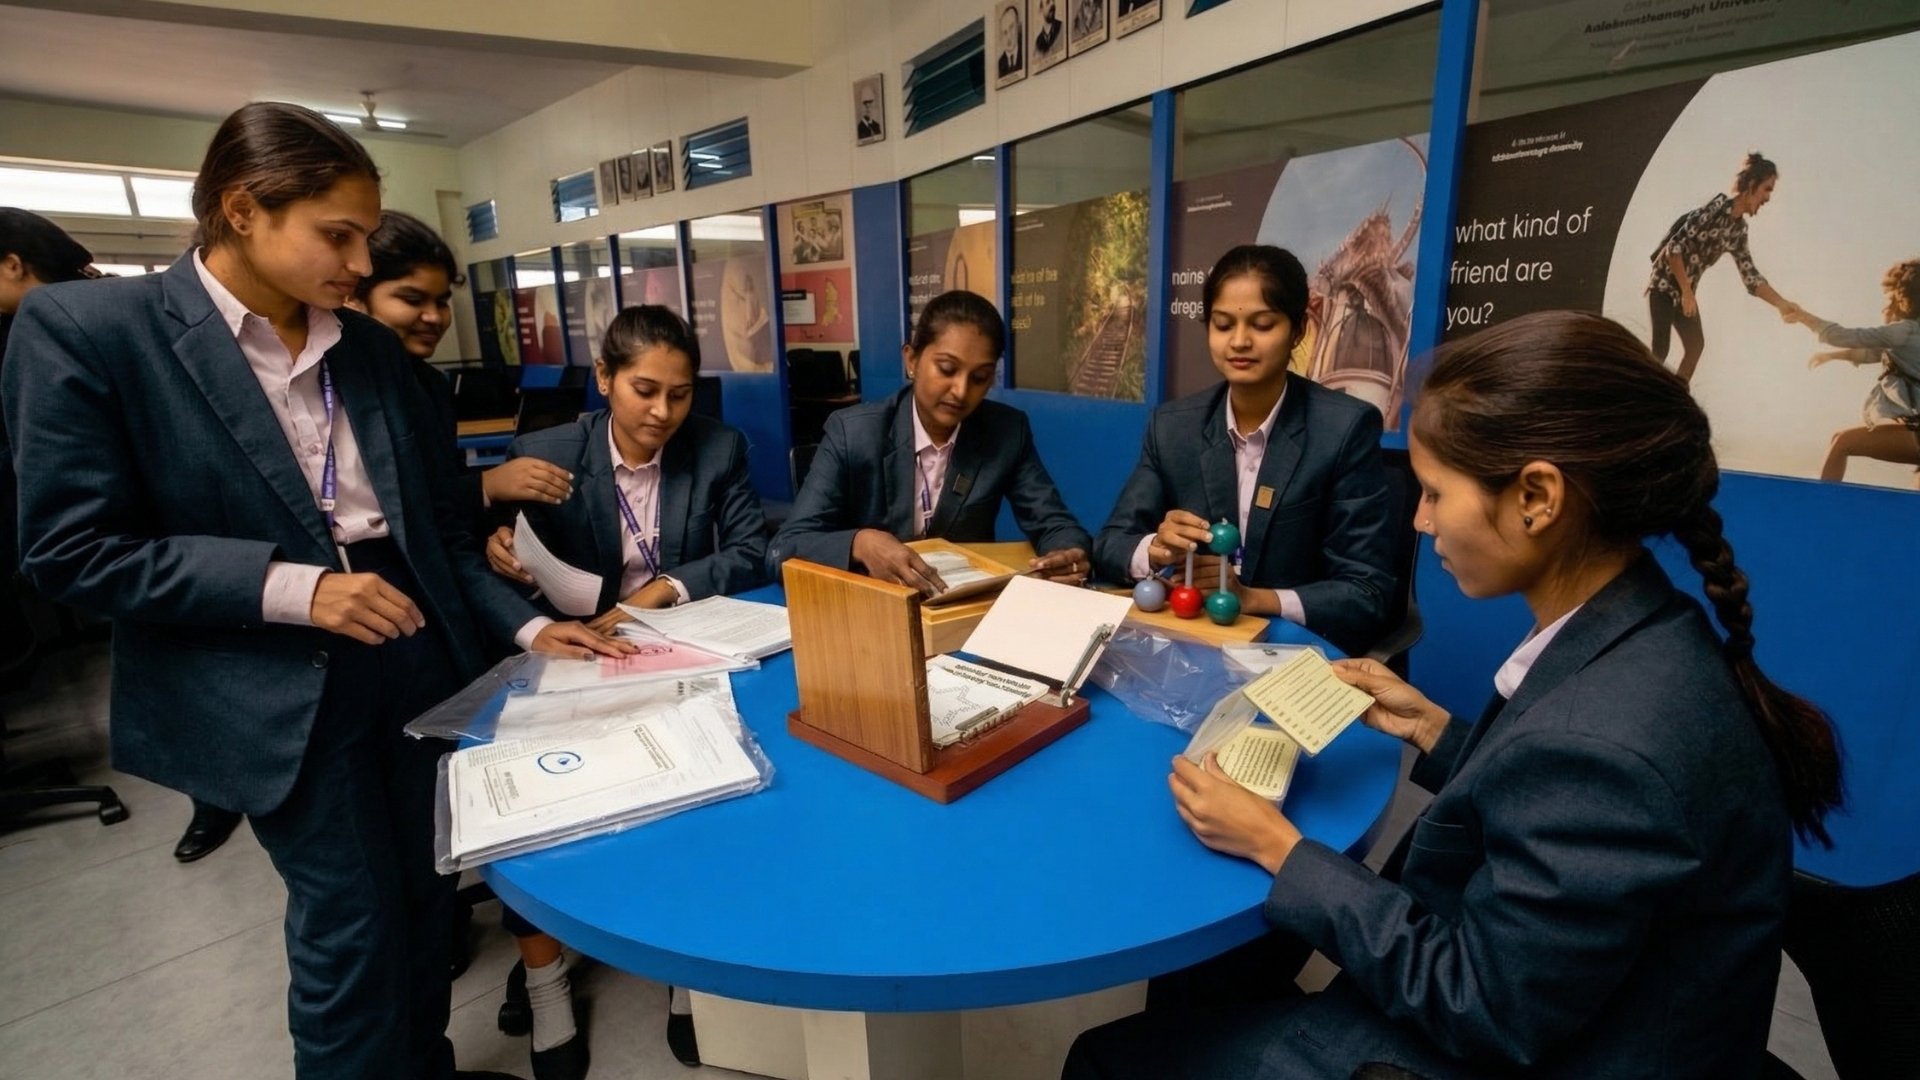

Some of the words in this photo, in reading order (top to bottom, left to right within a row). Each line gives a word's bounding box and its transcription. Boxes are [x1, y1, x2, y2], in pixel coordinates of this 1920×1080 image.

[1455, 217, 1506, 244] what
[1512, 209, 1560, 239] kind
[1566, 206, 1594, 234] of
[1450, 257, 1510, 285] friend
[1515, 261, 1553, 282] are
[1446, 302, 1494, 331] you?
